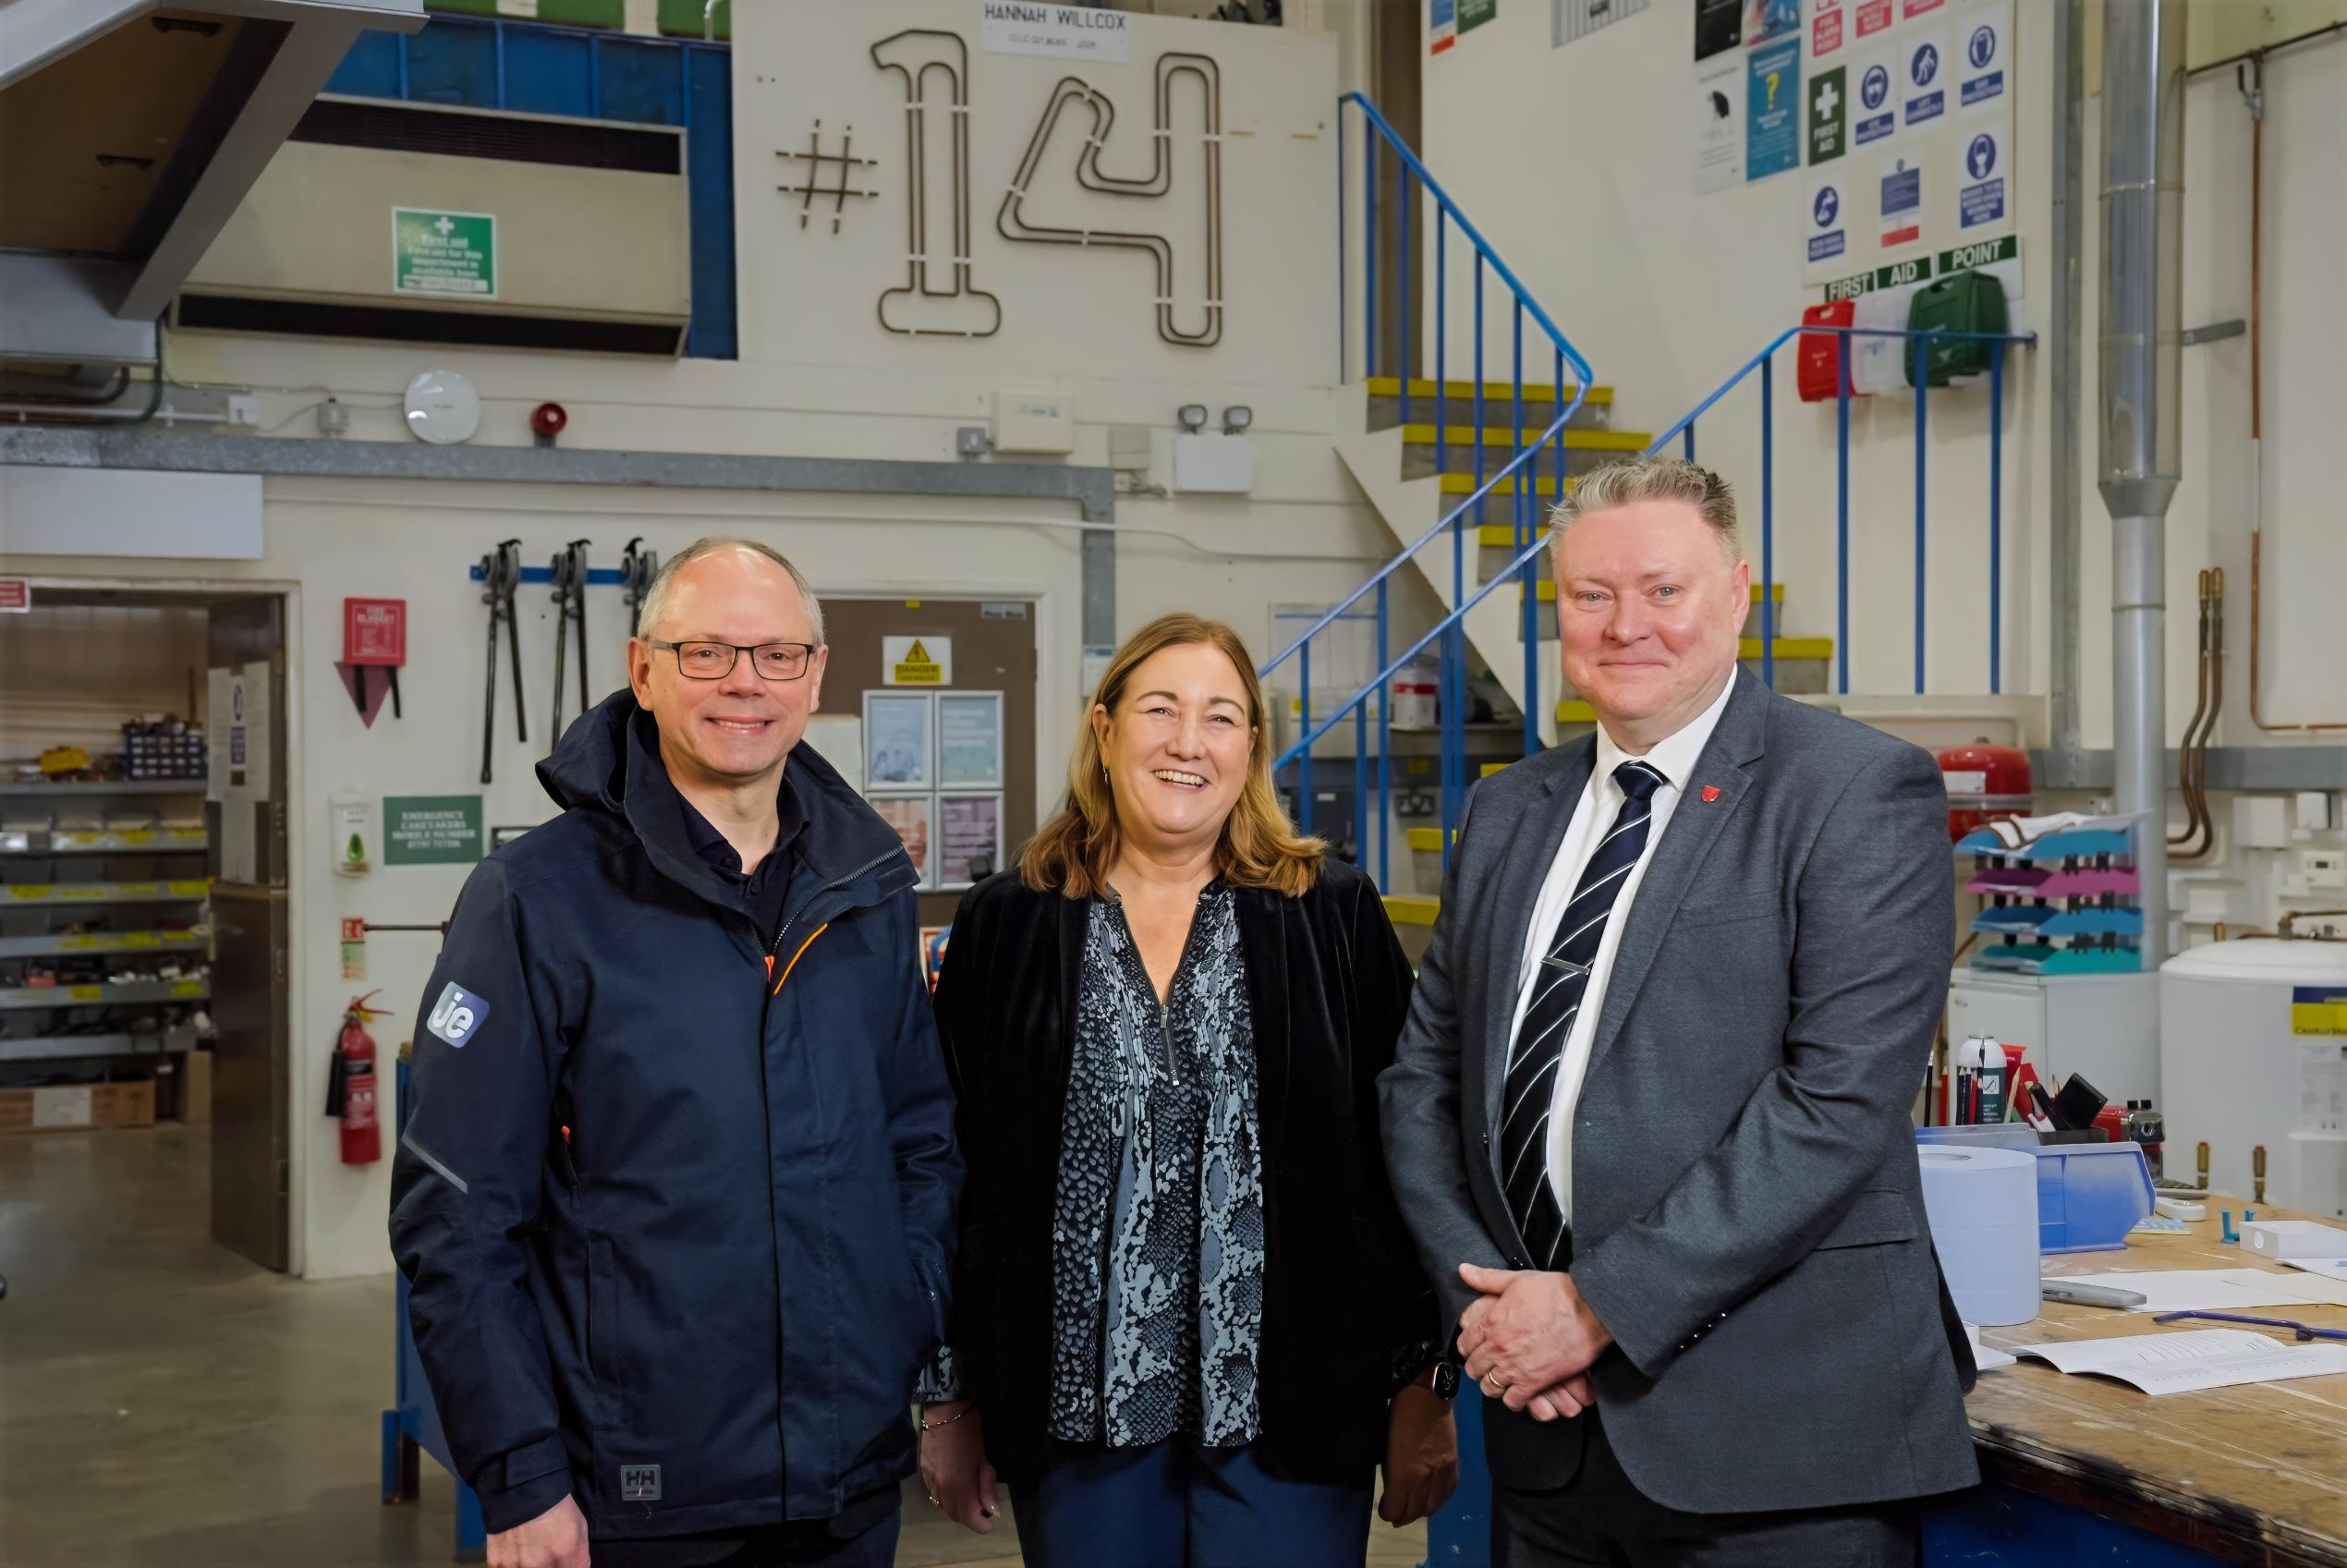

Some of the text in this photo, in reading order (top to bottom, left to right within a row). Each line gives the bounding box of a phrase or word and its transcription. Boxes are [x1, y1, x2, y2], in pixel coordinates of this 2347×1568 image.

[985, 3, 1126, 30] HANNAH WILLCOX
[1813, 121, 1840, 141] FIRST
[1818, 137, 1835, 153] AID
[1829, 239, 2003, 300] FIRST AID POINT
[401, 810, 464, 820] EMERGENCY
[400, 820, 467, 830] CARETAKERS
[432, 829, 476, 838] NUMBER
